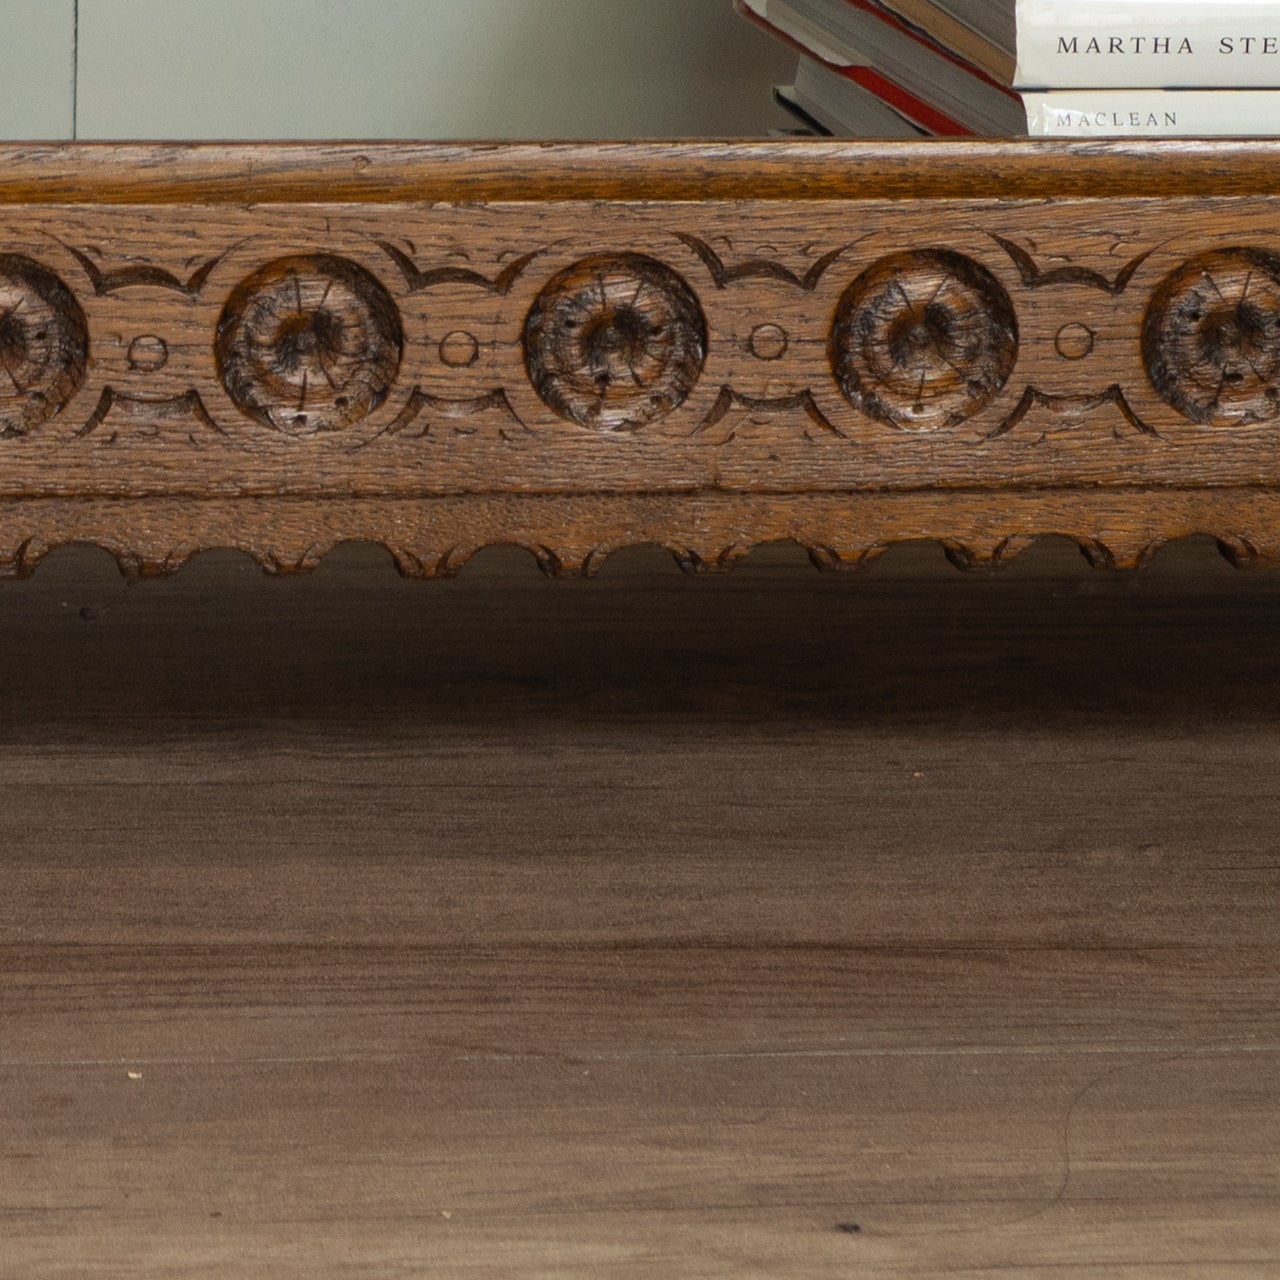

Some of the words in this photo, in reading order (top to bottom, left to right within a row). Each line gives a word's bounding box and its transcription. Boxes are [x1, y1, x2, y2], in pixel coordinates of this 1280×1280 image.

[1056, 36, 1194, 54] MARTHA
[1218, 36, 1278, 55] STE
[1056, 112, 1178, 128] MACLEAN
